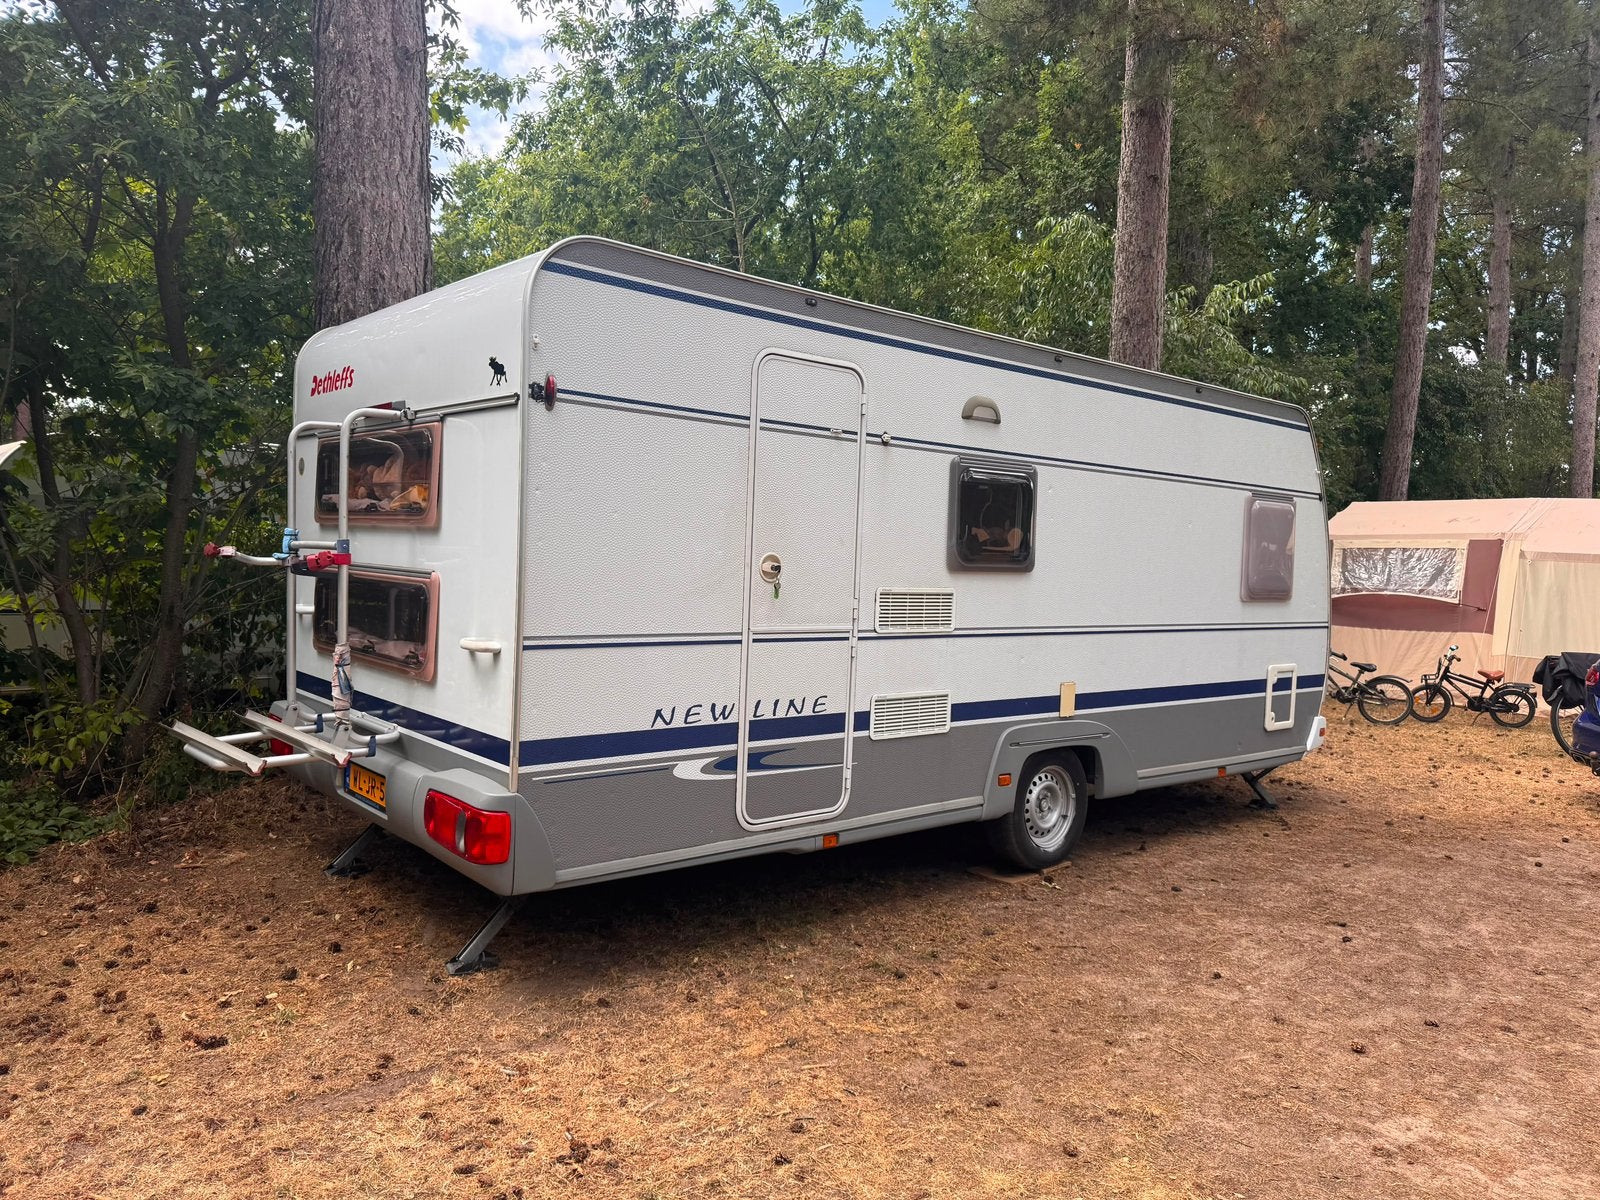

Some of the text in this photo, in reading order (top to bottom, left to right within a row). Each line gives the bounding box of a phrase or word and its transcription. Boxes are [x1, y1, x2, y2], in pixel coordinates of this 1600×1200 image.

[310, 365, 355, 397] Dethleffs
[651, 695, 828, 728] NEW LINE
